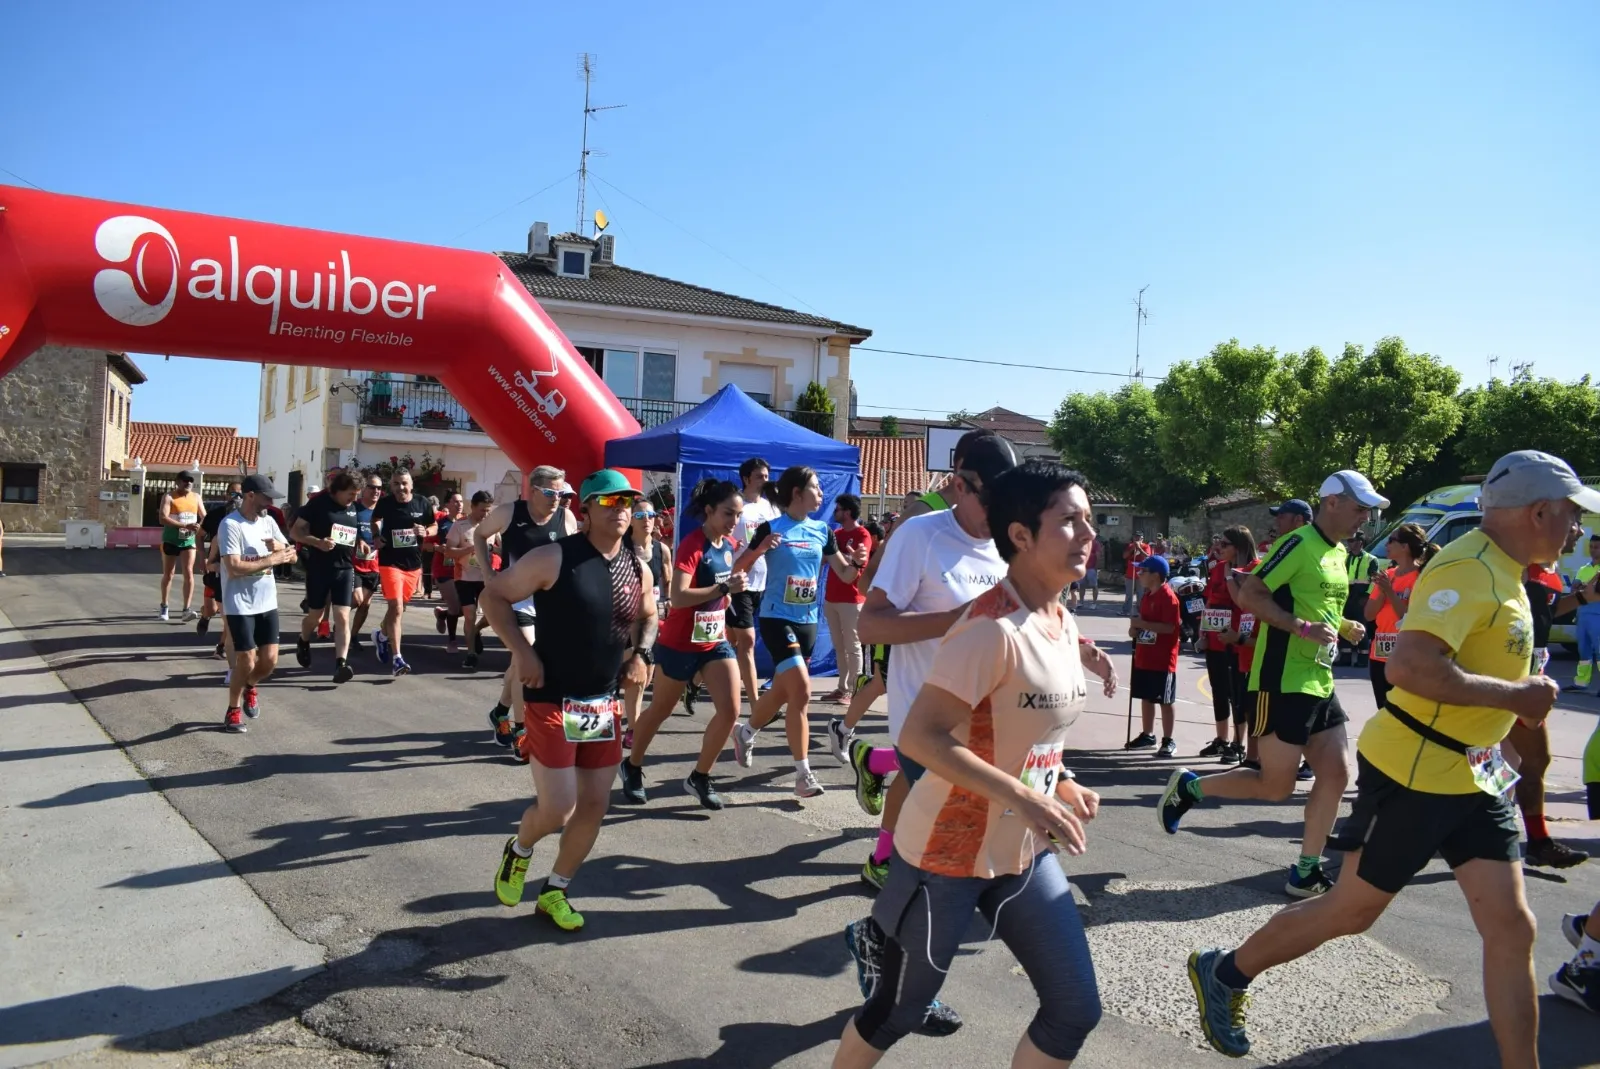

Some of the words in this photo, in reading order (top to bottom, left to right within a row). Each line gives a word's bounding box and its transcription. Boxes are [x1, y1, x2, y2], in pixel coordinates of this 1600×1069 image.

[187, 235, 437, 335] alquiber
[279, 321, 346, 344] Renting
[351, 328, 413, 347] Flexible
[487, 365, 557, 443] www.alquiber.es
[338, 531, 348, 540] 91
[794, 586, 815, 598] 188
[705, 622, 718, 635] 59
[1207, 617, 1224, 627] 131
[1039, 693, 1068, 702] MEDIA
[579, 714, 600, 731] 26
[1044, 769, 1054, 795] 9
